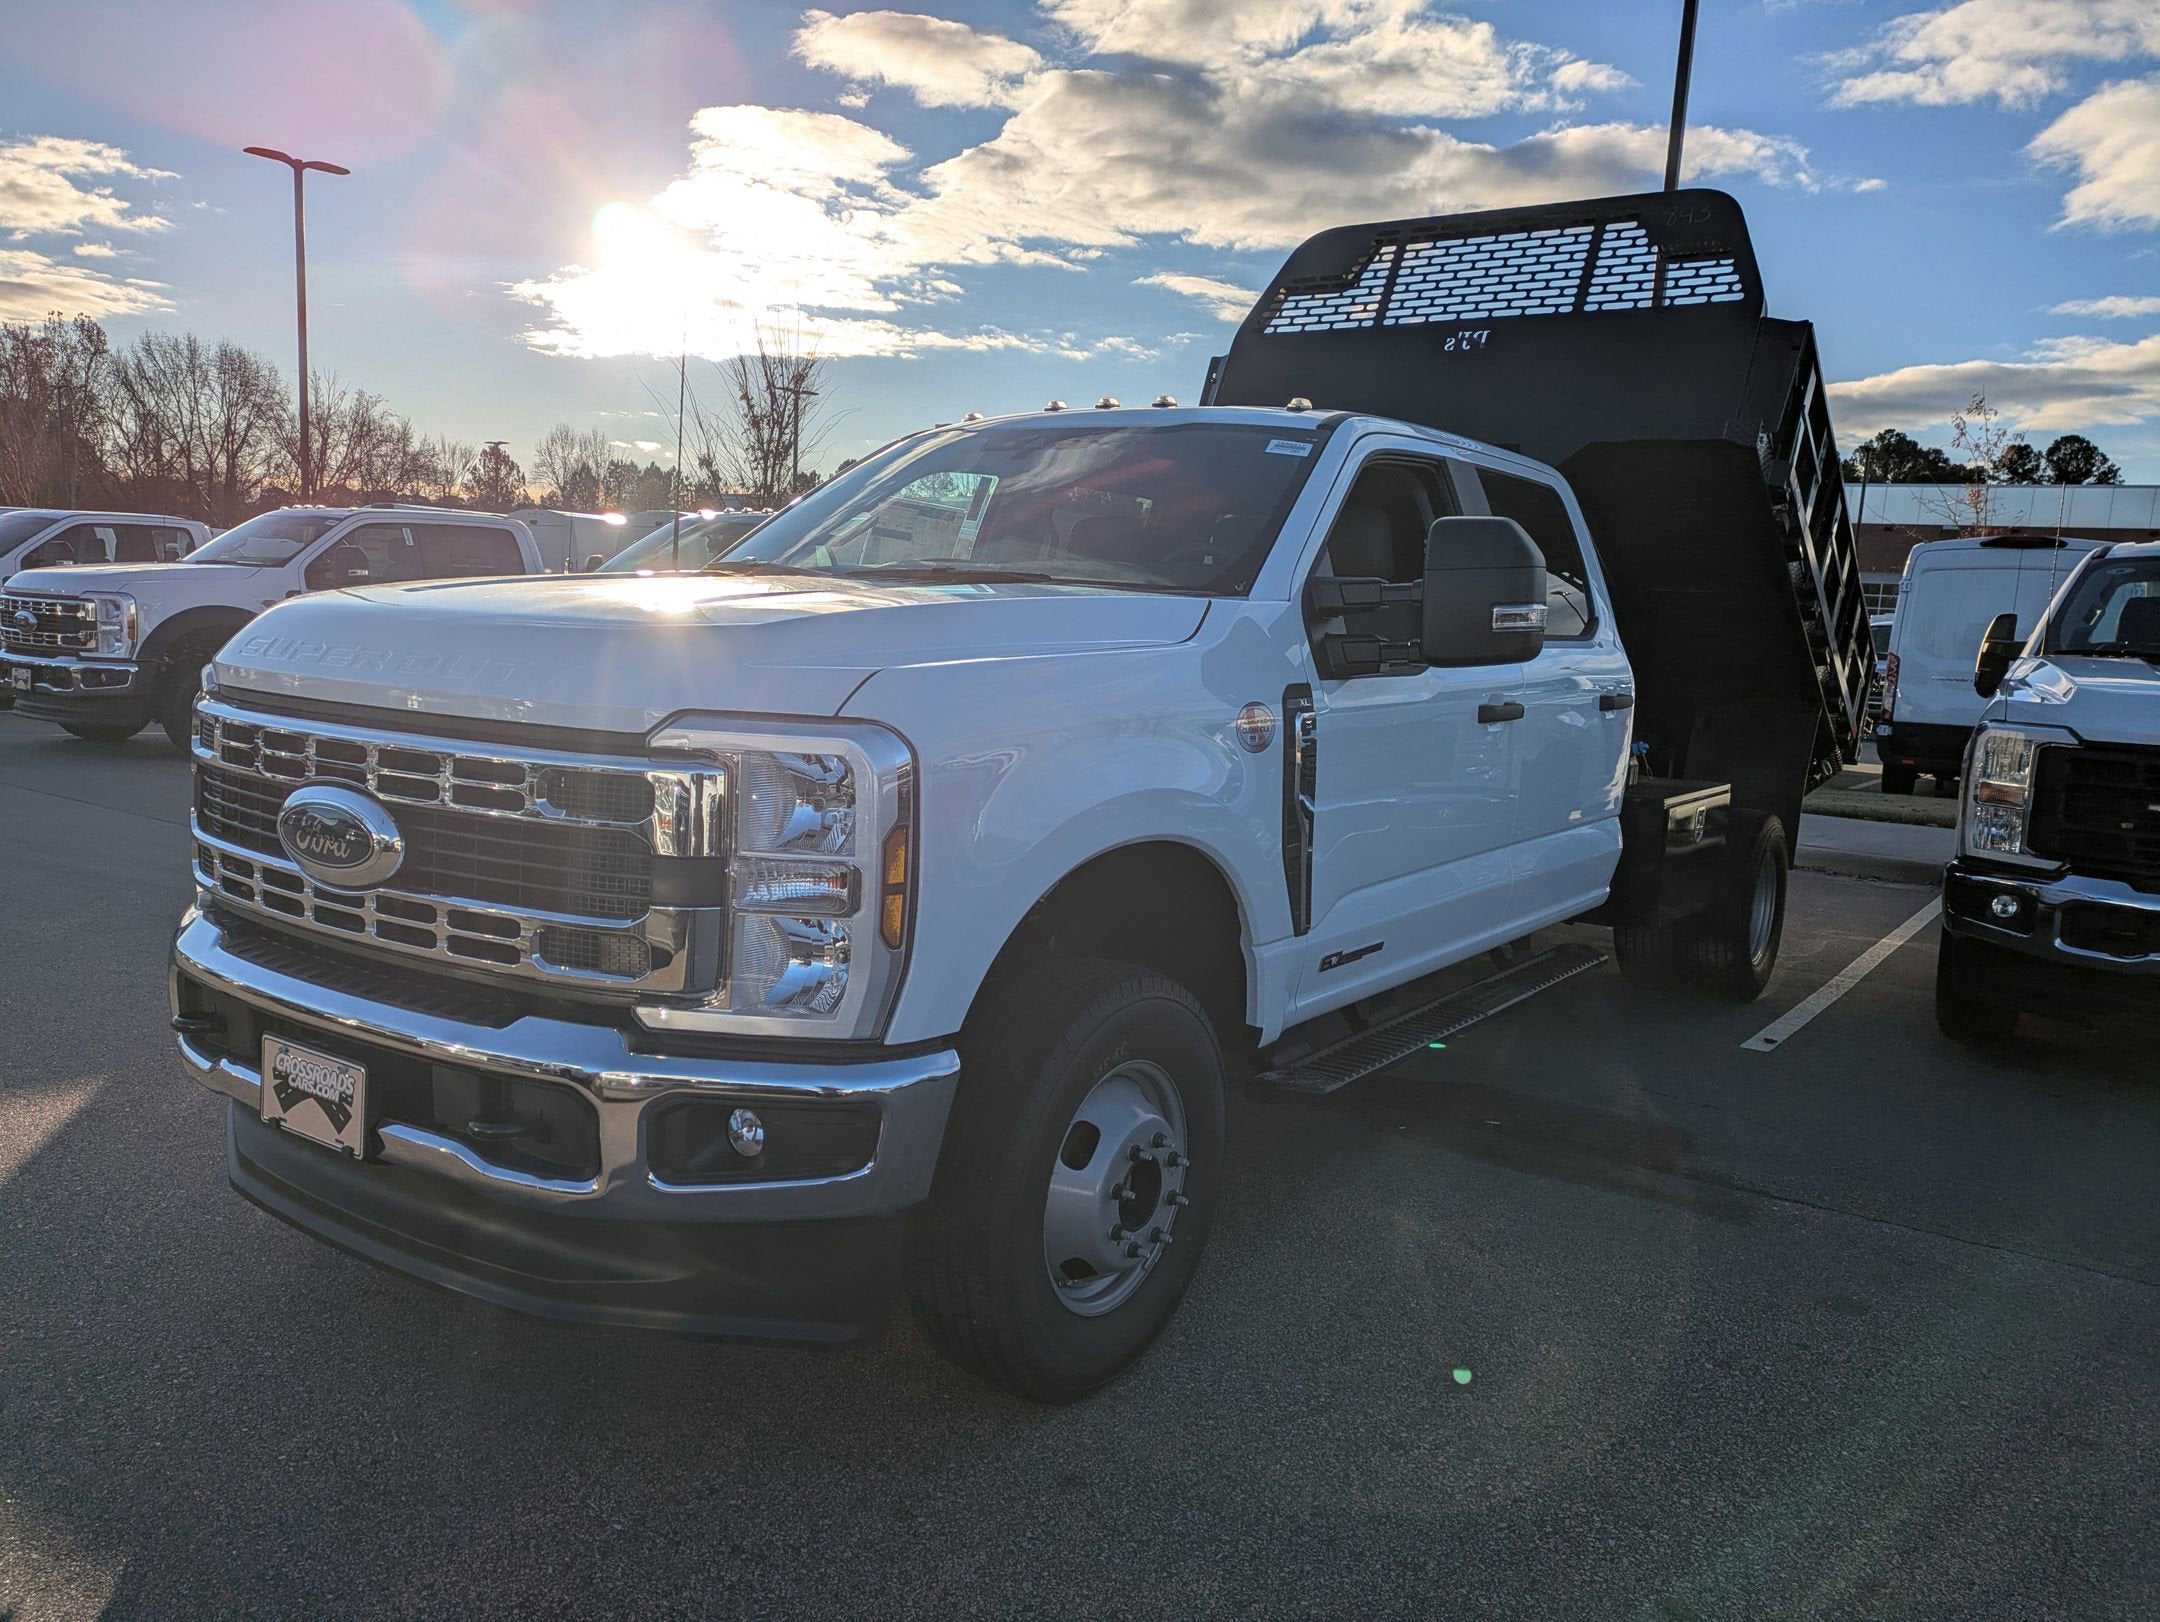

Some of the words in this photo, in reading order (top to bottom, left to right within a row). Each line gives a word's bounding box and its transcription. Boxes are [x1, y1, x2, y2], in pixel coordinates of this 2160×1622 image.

[237, 635, 394, 671] SUPER
[1299, 698, 1311, 707] XL
[1242, 726, 1259, 735] CLEAN
[296, 812, 351, 858] Ford
[275, 1053, 355, 1096] CROSSROADS
[288, 1074, 340, 1103] CARS.COM
